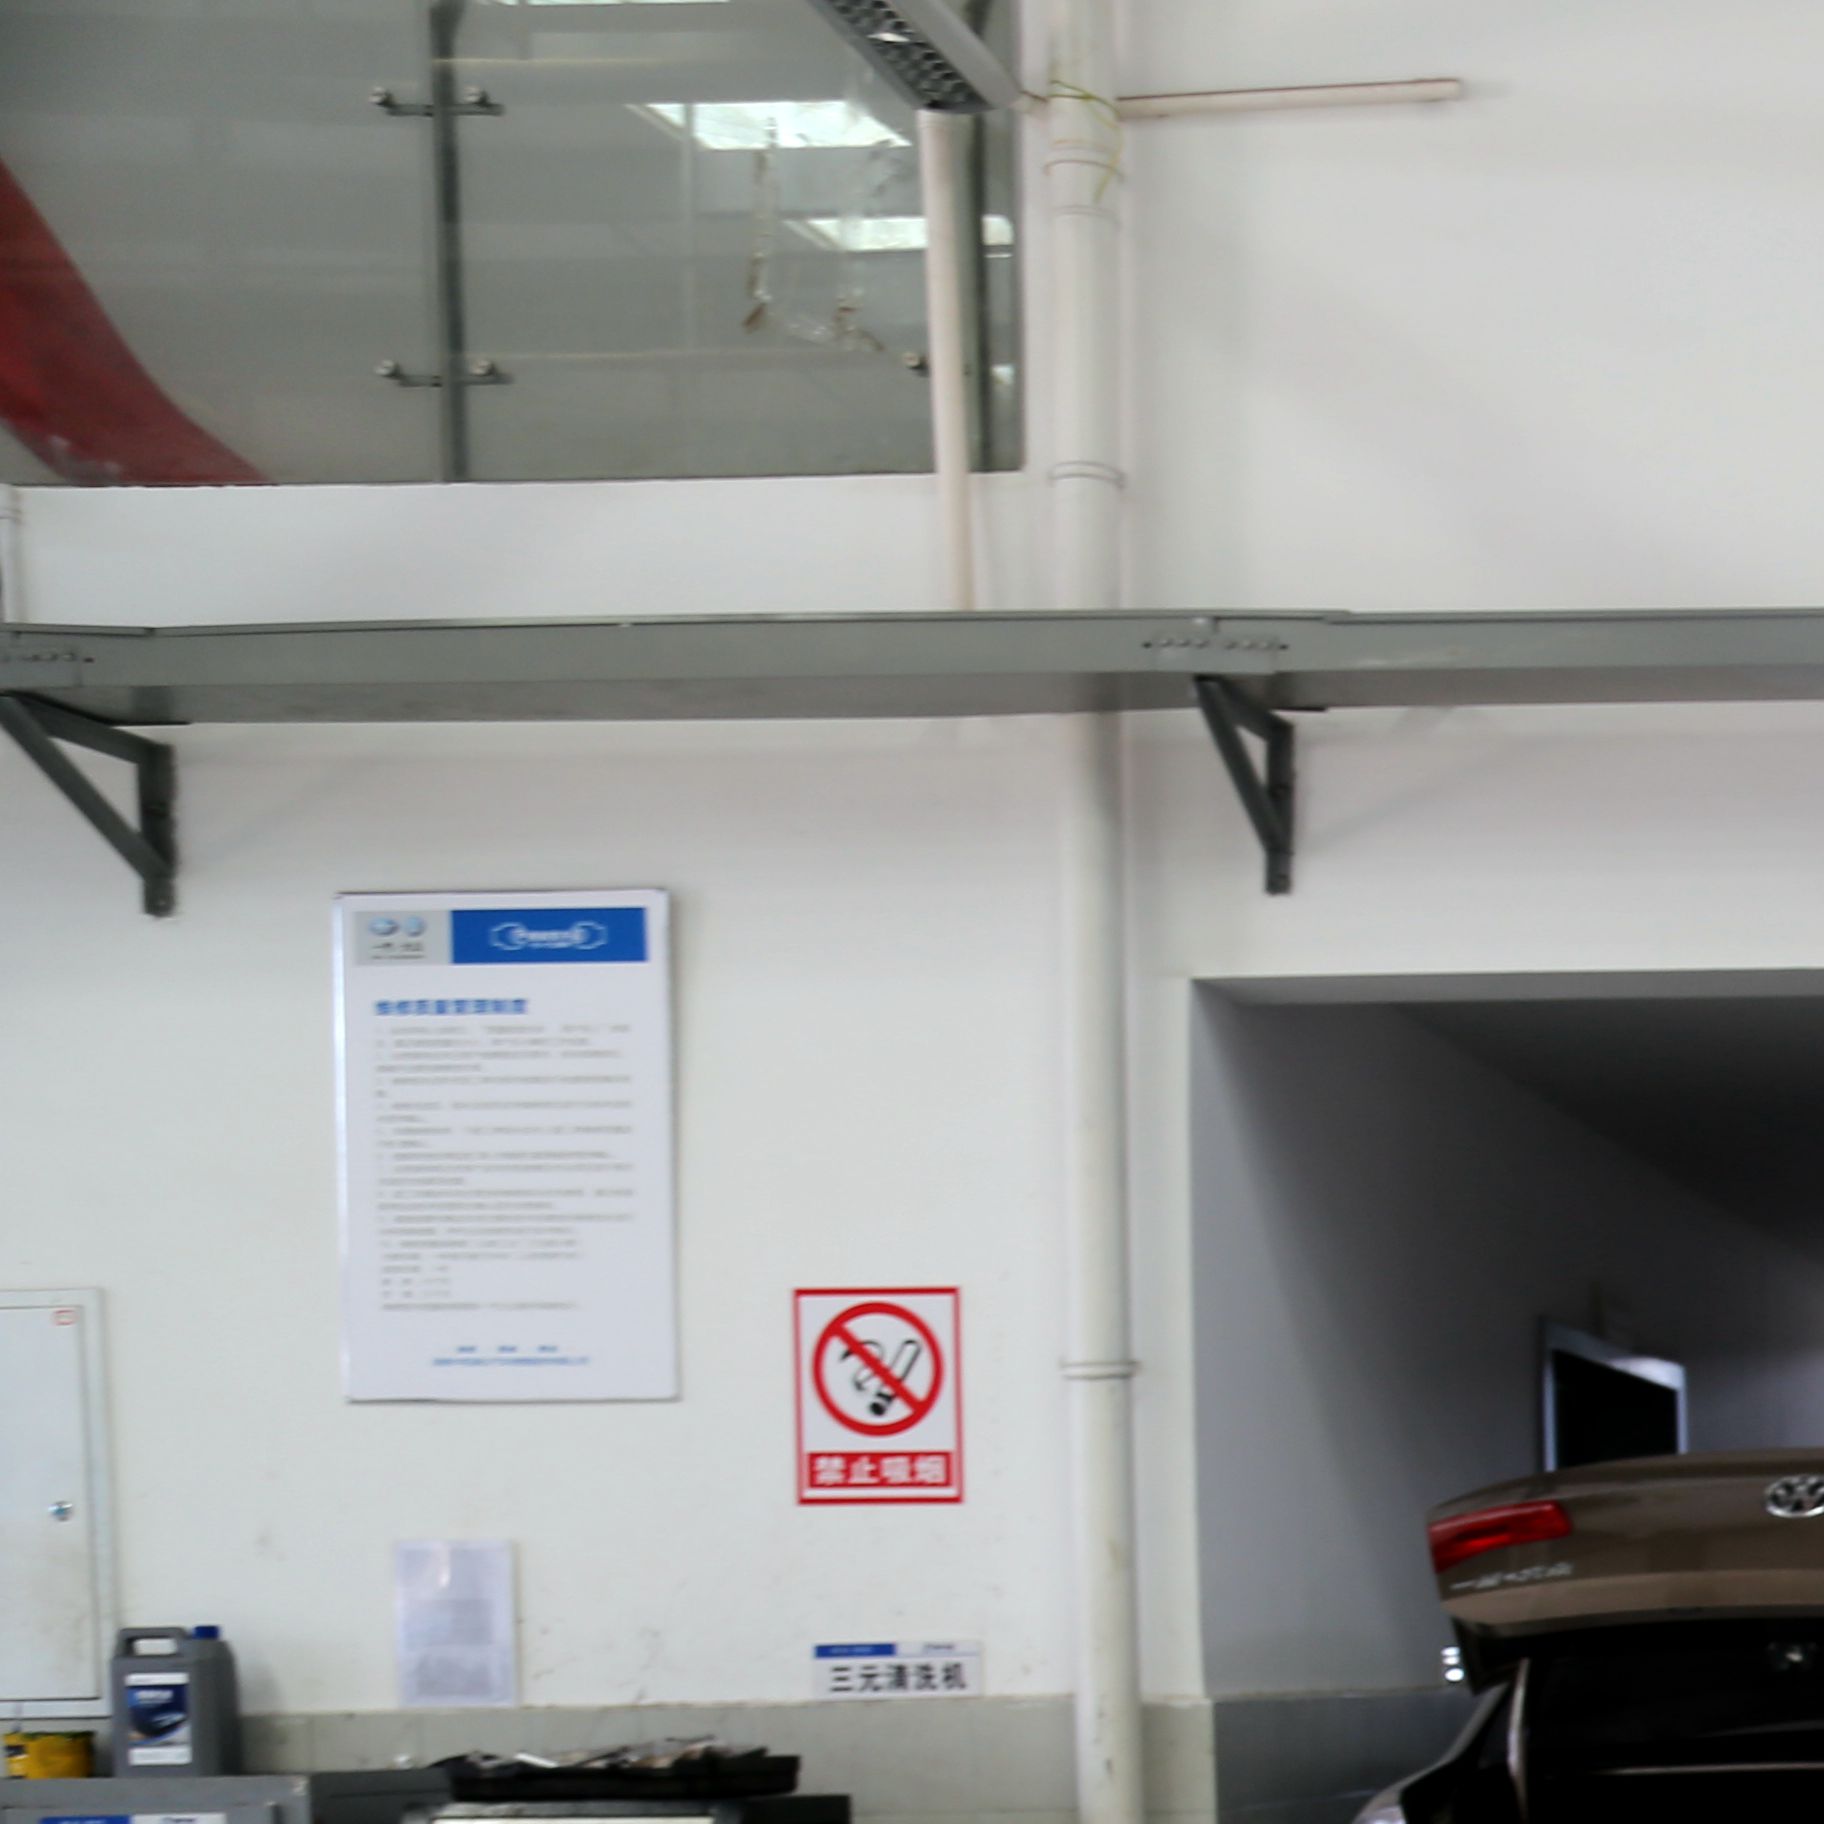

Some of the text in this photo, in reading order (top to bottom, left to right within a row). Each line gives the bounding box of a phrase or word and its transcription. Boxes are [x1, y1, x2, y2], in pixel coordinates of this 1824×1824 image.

[814, 1455, 948, 1487] 禁止吸烟
[829, 1662, 969, 1694] 三元清洗机
